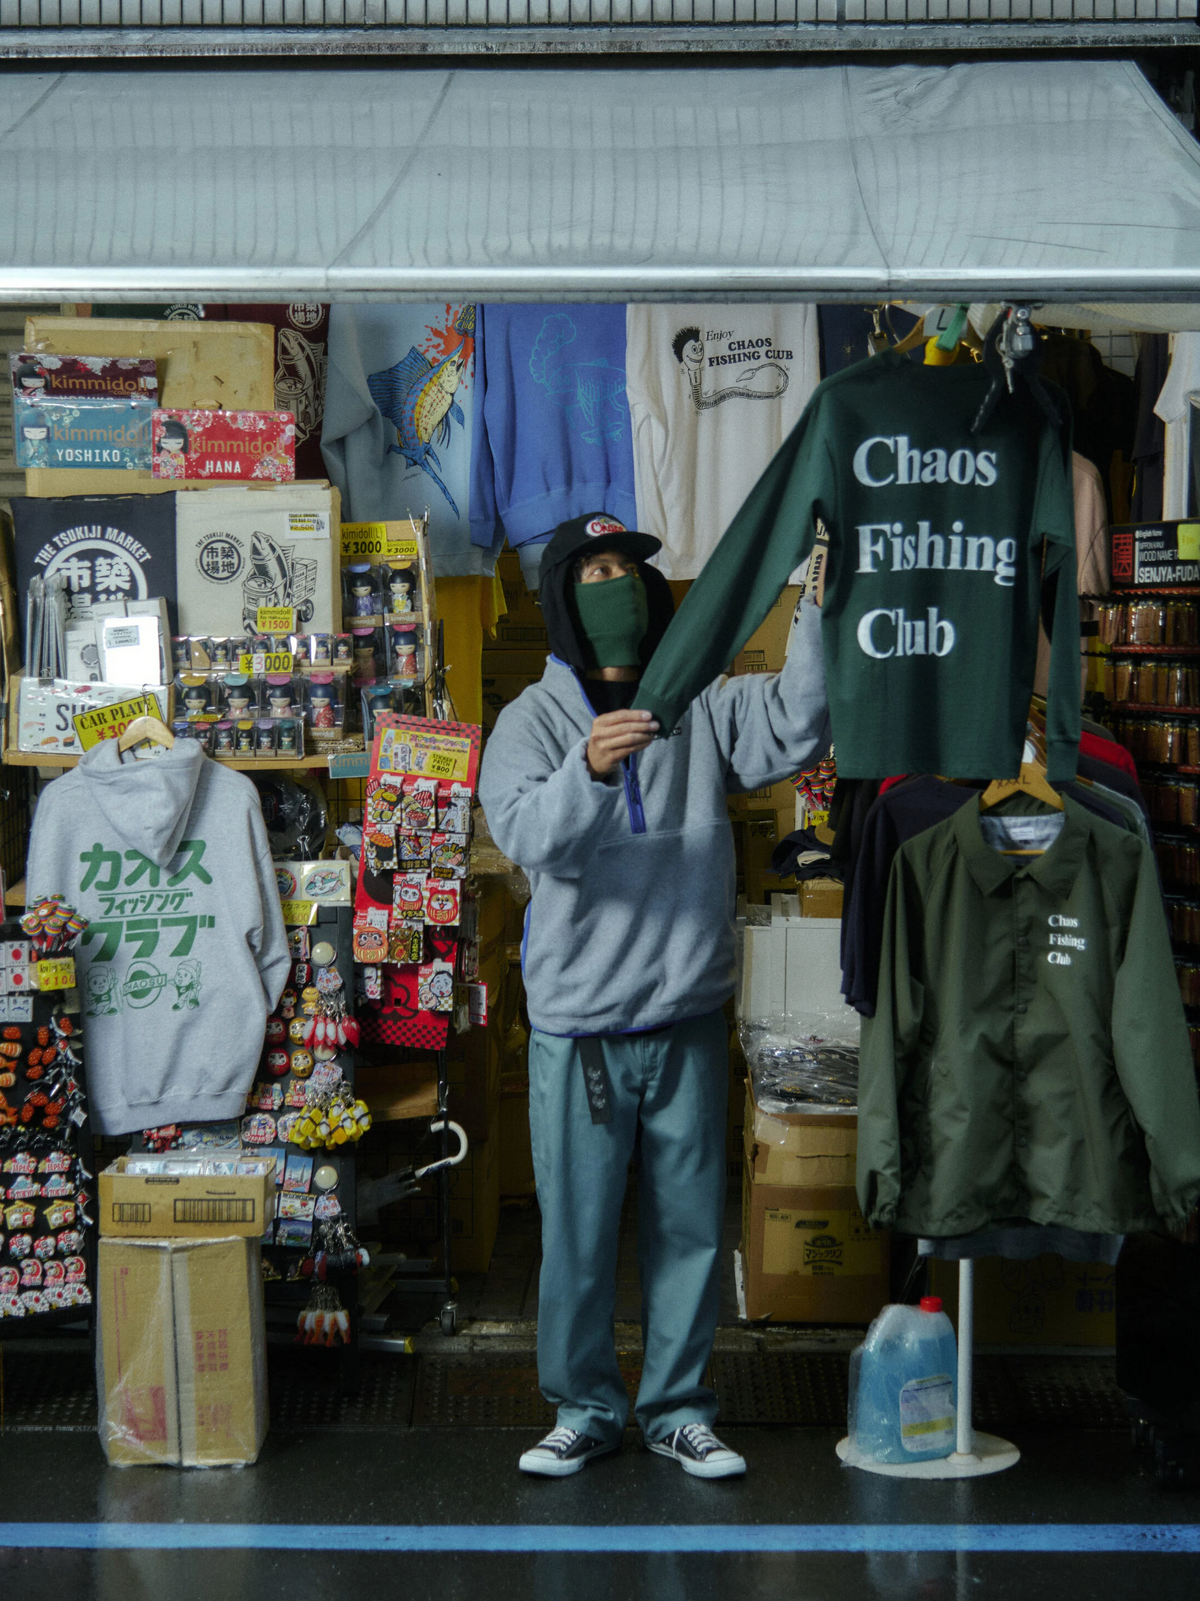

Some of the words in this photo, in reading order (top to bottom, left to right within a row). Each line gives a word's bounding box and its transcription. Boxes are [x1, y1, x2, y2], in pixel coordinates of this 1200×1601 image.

[705, 329, 735, 341] Enjoy
[727, 338, 772, 352] CHAOS
[708, 351, 761, 367] FISHING
[765, 350, 794, 360] CLUB
[51, 374, 148, 392] kimmidoll
[53, 424, 149, 442] kimmidoll
[191, 435, 285, 454] kimmidoll
[56, 449, 121, 462] YOSHIKO
[852, 435, 997, 487] Chaos
[205, 460, 242, 473] HANA
[34, 543, 58, 566] THE
[52, 525, 101, 548] TSUKIJI
[105, 526, 152, 563] MARKET
[342, 541, 382, 554] ¥3000
[855, 520, 1016, 586] Fishing
[1139, 551, 1157, 561] WOOD
[1157, 550, 1173, 561] NAME
[1138, 565, 1200, 583] SENJYA-FUDA
[261, 620, 290, 630] ¥1500
[857, 606, 956, 659] Club
[245, 654, 290, 672] ¥3000
[80, 713, 109, 730] CAR
[110, 697, 154, 721] PLATE
[432, 753, 454, 763] STICKER
[433, 758, 451, 767] PATCH
[79, 839, 214, 893] カオス
[98, 892, 194, 916] フィッシング
[1048, 914, 1078, 928] Chaos
[80, 915, 216, 963] クラブ
[1049, 933, 1086, 950] Fishing
[1047, 951, 1072, 965] Club
[123, 974, 167, 995] CHAOSU
